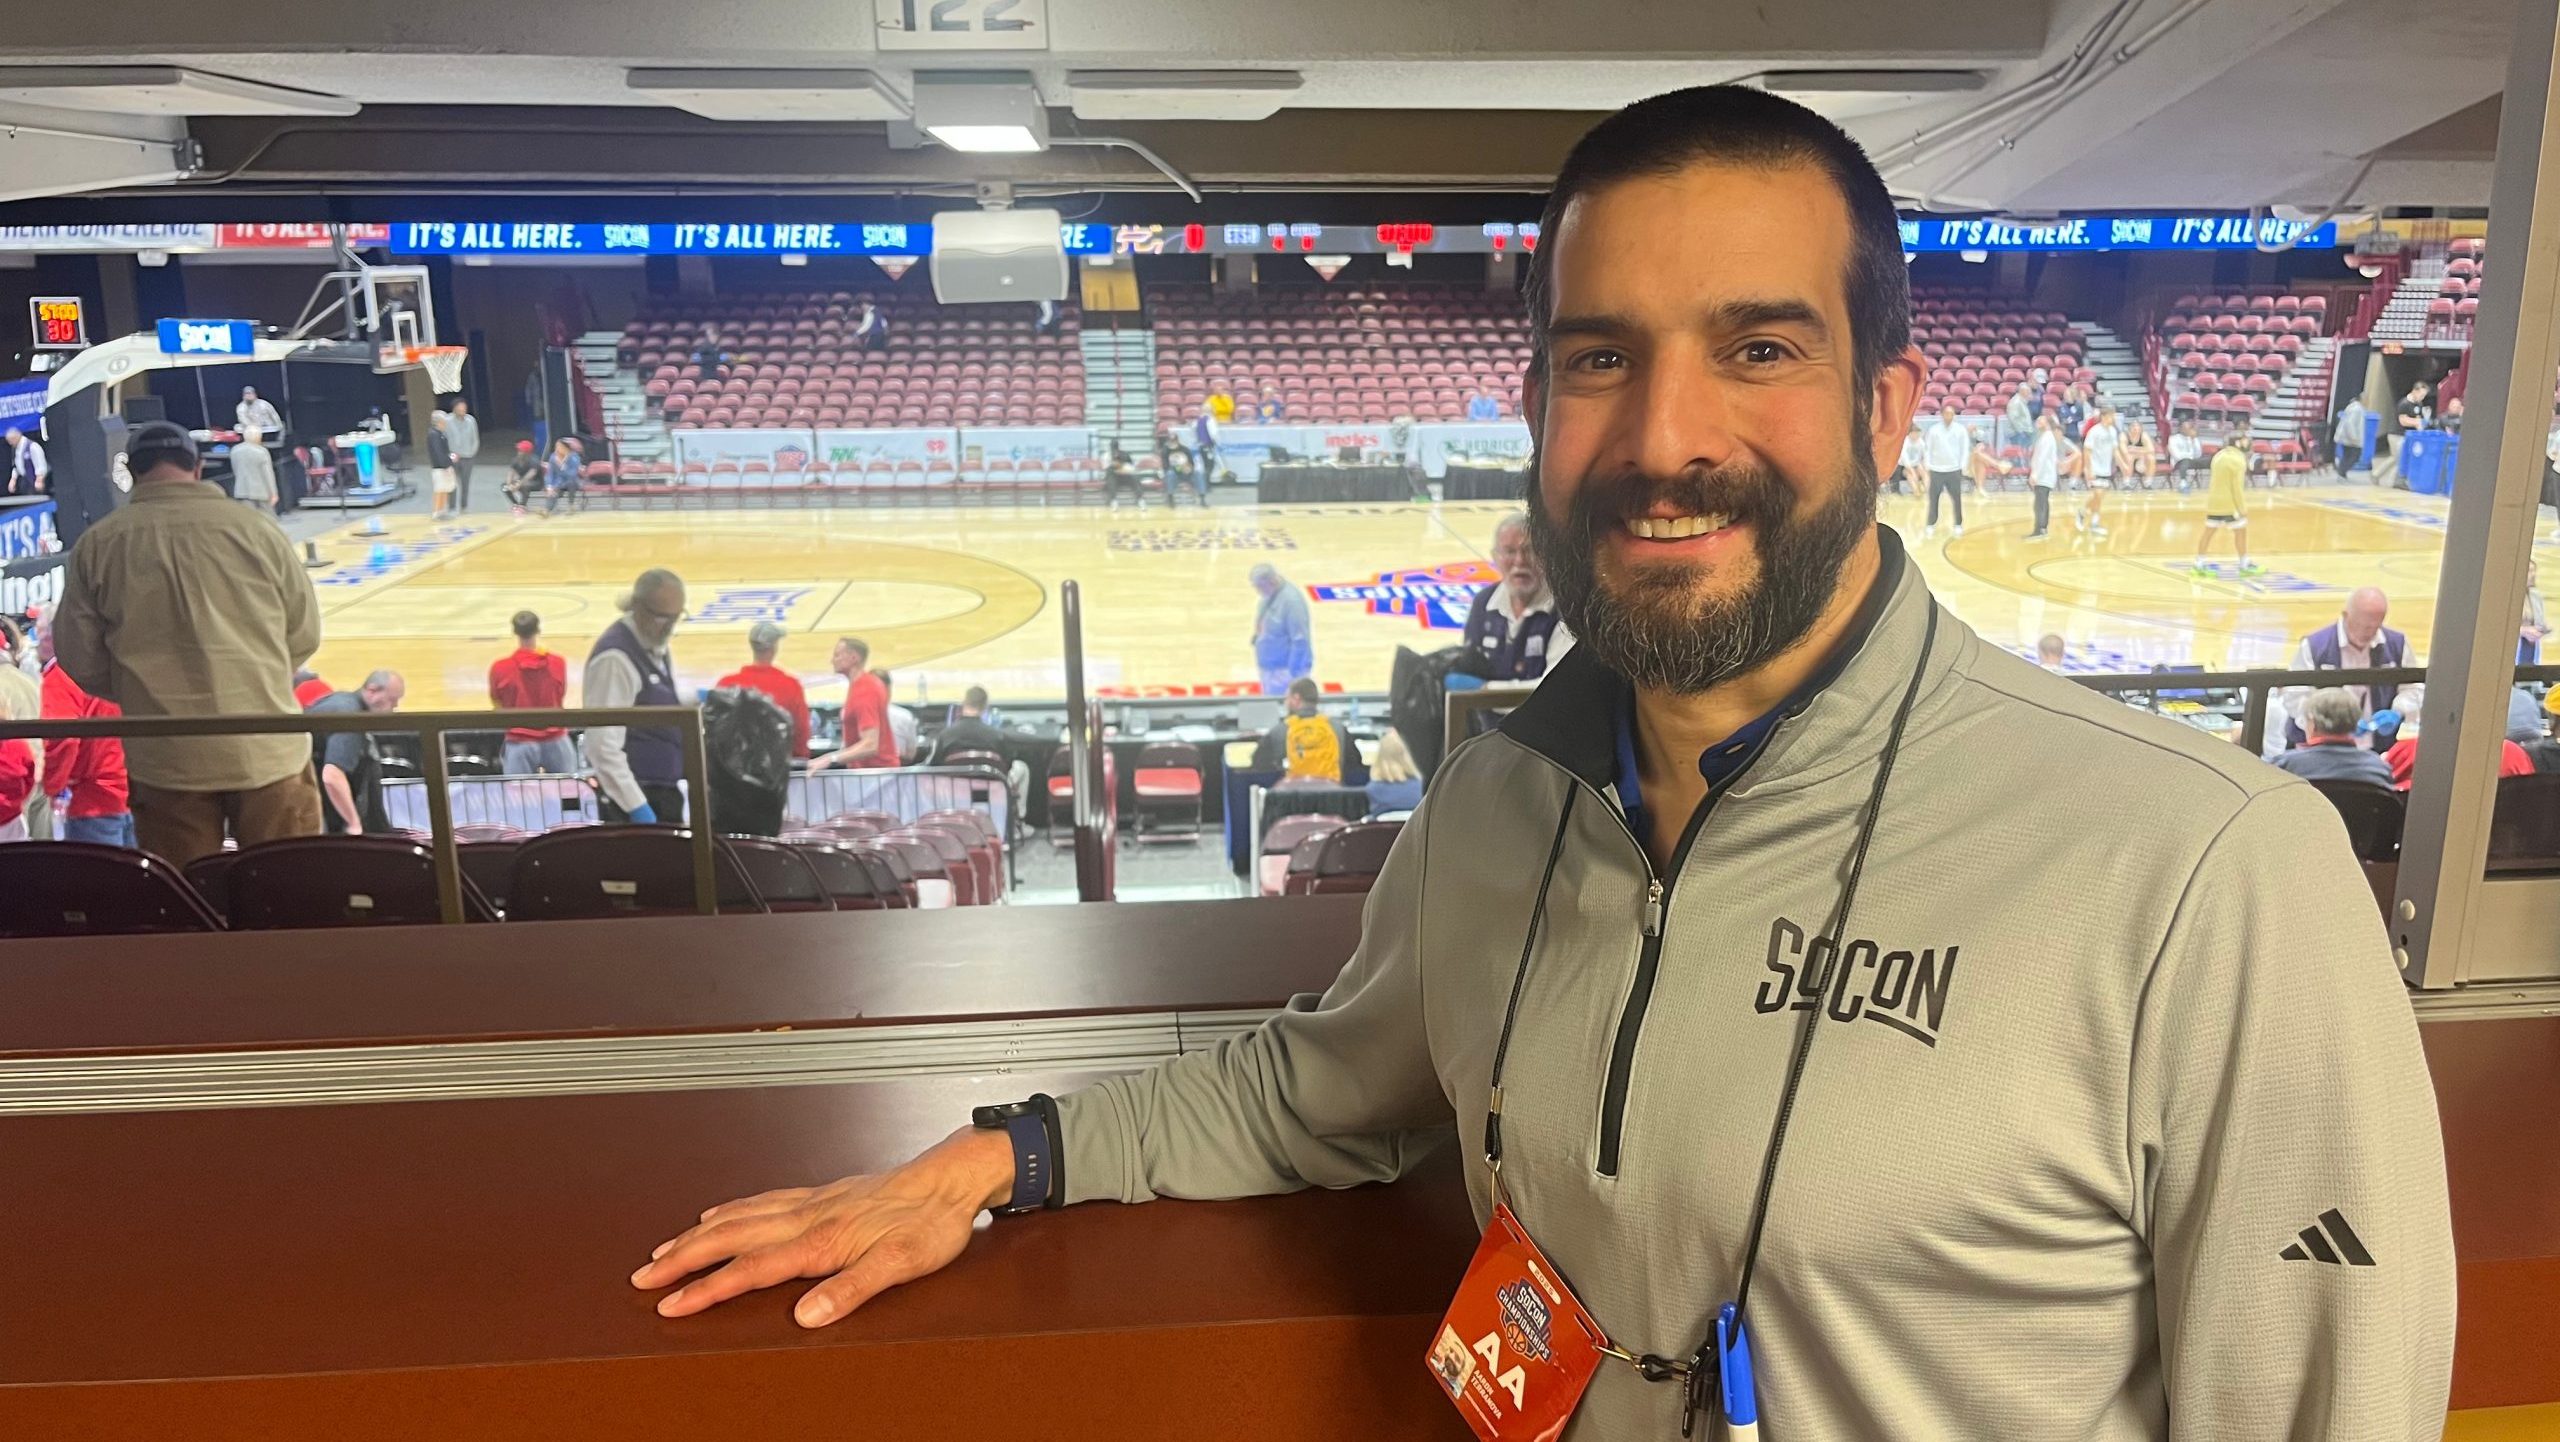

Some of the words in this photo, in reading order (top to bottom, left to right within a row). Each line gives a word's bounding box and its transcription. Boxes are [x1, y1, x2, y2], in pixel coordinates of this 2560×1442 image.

[408, 223, 455, 248] IT'S
[461, 223, 505, 248] ALL
[512, 223, 582, 248] HERE.
[674, 224, 720, 248] IT'S
[724, 224, 767, 248] ALL
[773, 224, 841, 248] HERE.
[1940, 221, 1983, 245] IT'S
[1984, 223, 2023, 245] ALL
[2171, 219, 2215, 243] IT'S
[2215, 219, 2254, 243] ALL
[48, 320, 75, 341] 30
[1754, 916, 1960, 1044] SOCON
[1534, 1268, 1554, 1296] 2025
[1517, 1286, 1547, 1329] SOCON
[1498, 1289, 1550, 1359] CHAMPIONSHIPS
[1472, 1331, 1526, 1412] AA
[1473, 1369, 1494, 1396] AARON
[1471, 1376, 1502, 1420] TERRANOVA
